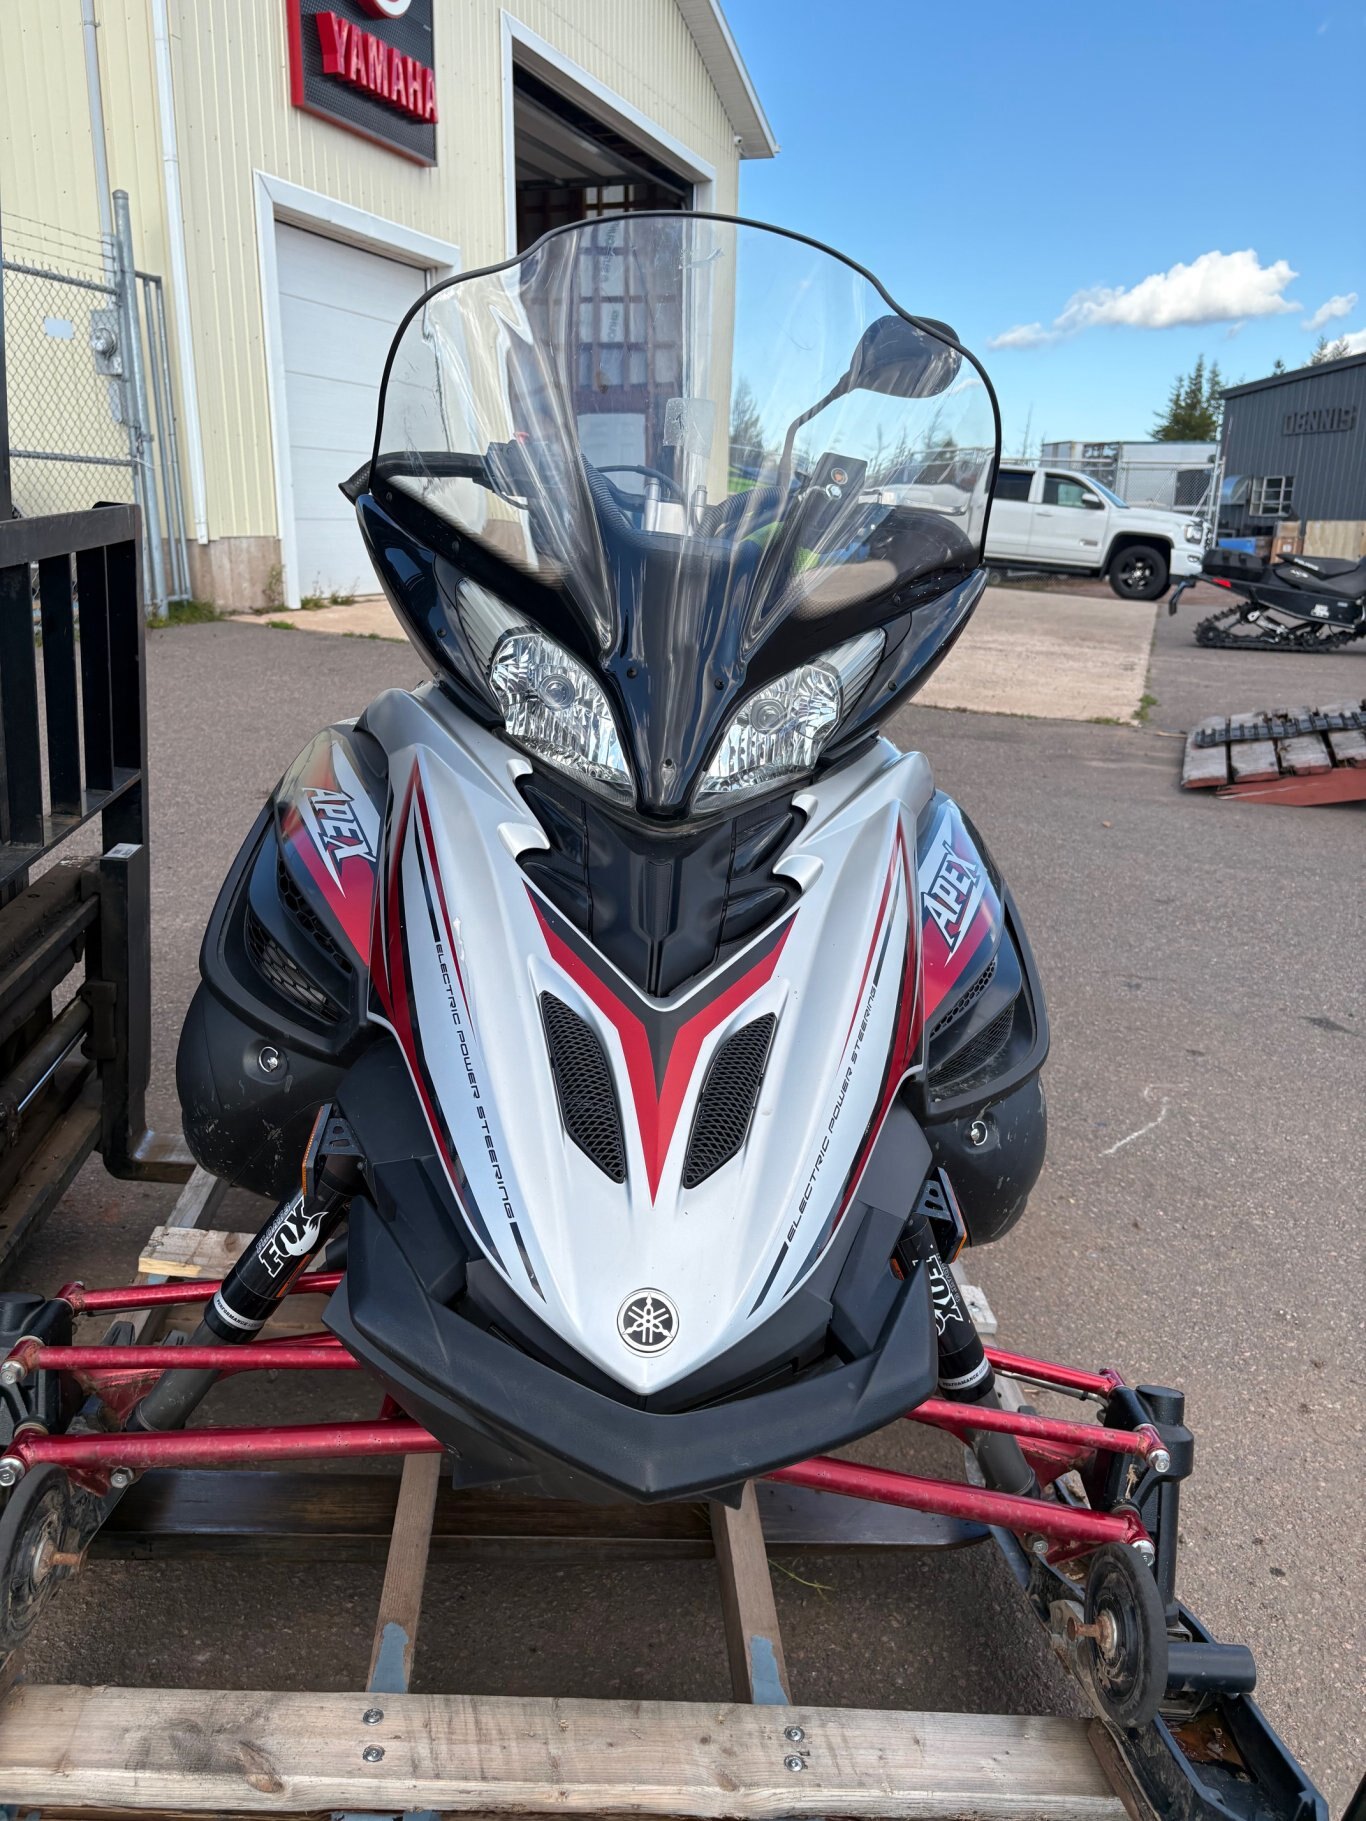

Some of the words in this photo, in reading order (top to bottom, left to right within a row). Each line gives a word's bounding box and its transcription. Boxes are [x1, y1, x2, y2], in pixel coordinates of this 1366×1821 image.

[316, 11, 438, 124] YAMAHA
[302, 787, 377, 863] APEX
[922, 840, 979, 948] APEX
[435, 943, 461, 1025] ELECTRIC
[456, 1030, 480, 1099] POWER
[476, 1105, 515, 1219] STEERING
[786, 1135, 830, 1243] ELECTRIC
[828, 1066, 853, 1133] POWER
[850, 985, 877, 1064] STEERING
[258, 1195, 316, 1278] FOX
[925, 1254, 964, 1325] FOX
